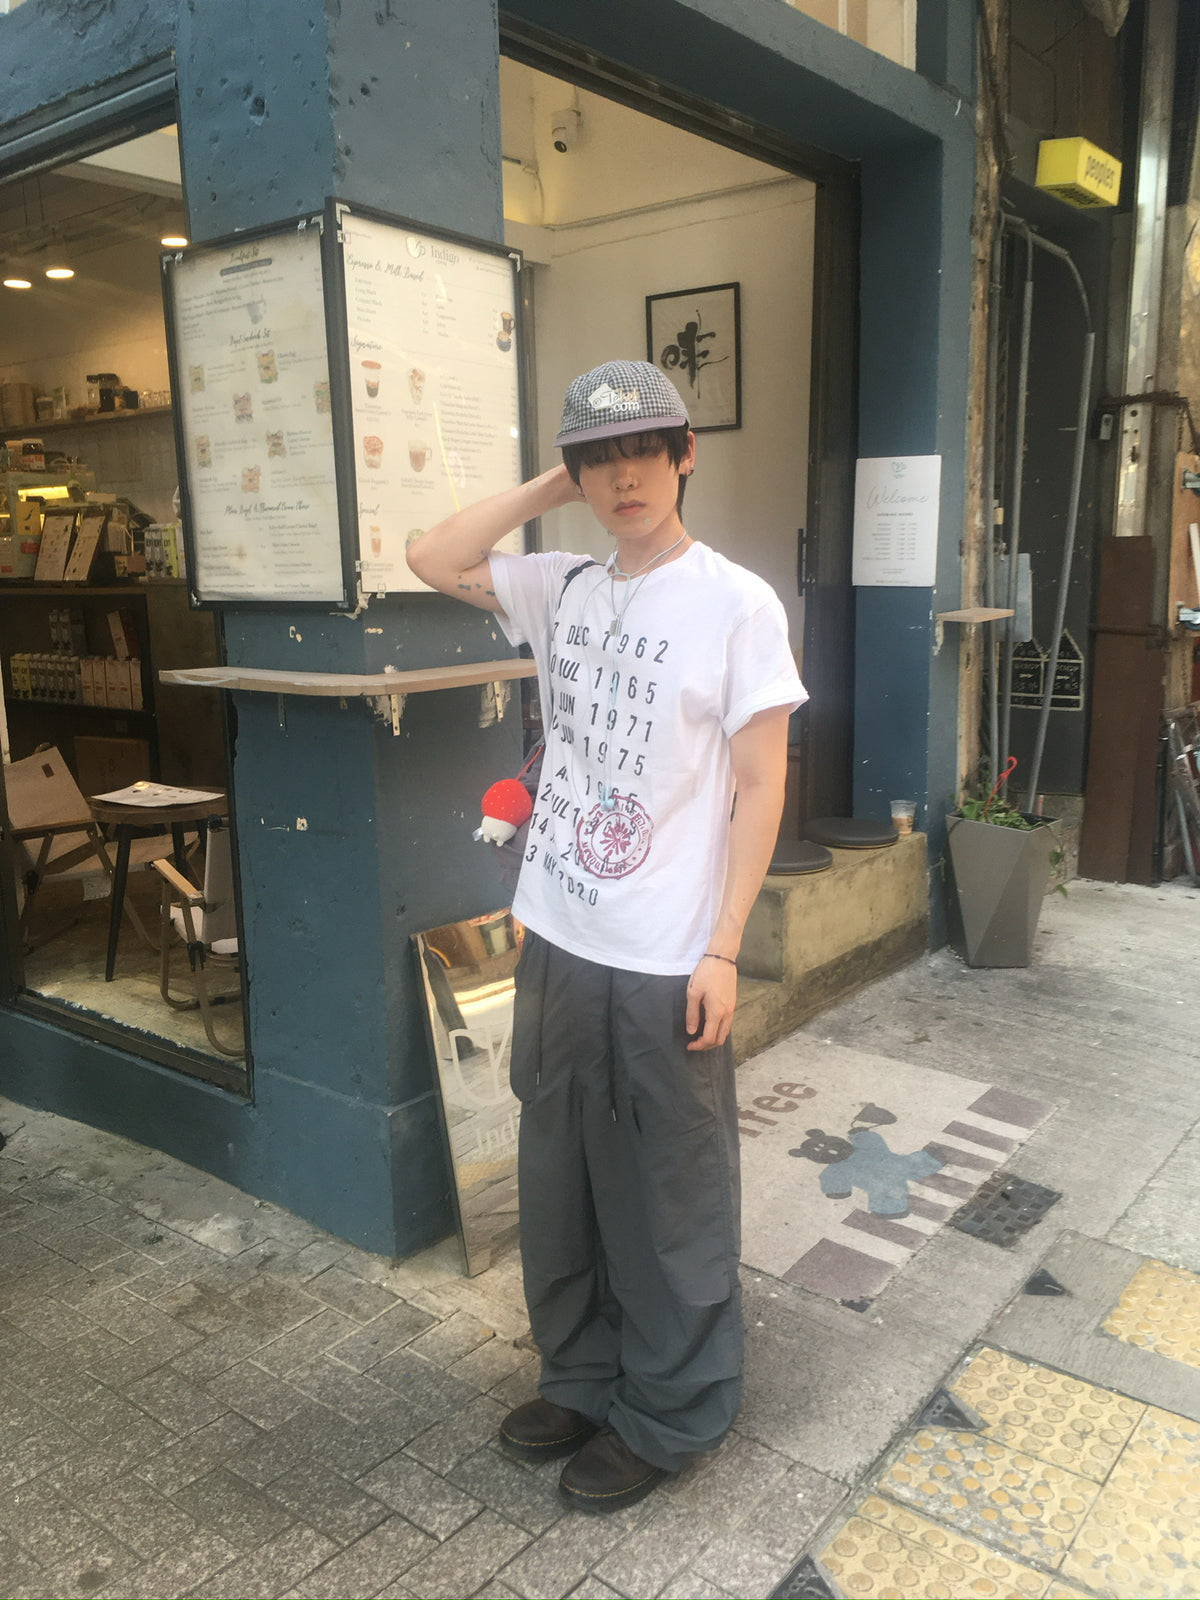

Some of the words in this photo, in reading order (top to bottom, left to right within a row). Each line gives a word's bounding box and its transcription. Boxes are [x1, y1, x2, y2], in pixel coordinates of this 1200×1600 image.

[431, 245, 460, 264] Indigo
[351, 334, 383, 352] Signature
[865, 485, 929, 510] Welcome
[566, 624, 590, 646] DEC
[602, 630, 669, 664] 1962
[595, 666, 658, 704] 1965
[559, 691, 576, 716] JUN
[590, 702, 653, 743] 1971
[583, 735, 646, 777] 1975
[540, 783, 552, 802] 2
[526, 844, 538, 862] 3
[475, 1110, 521, 1154] Ind
